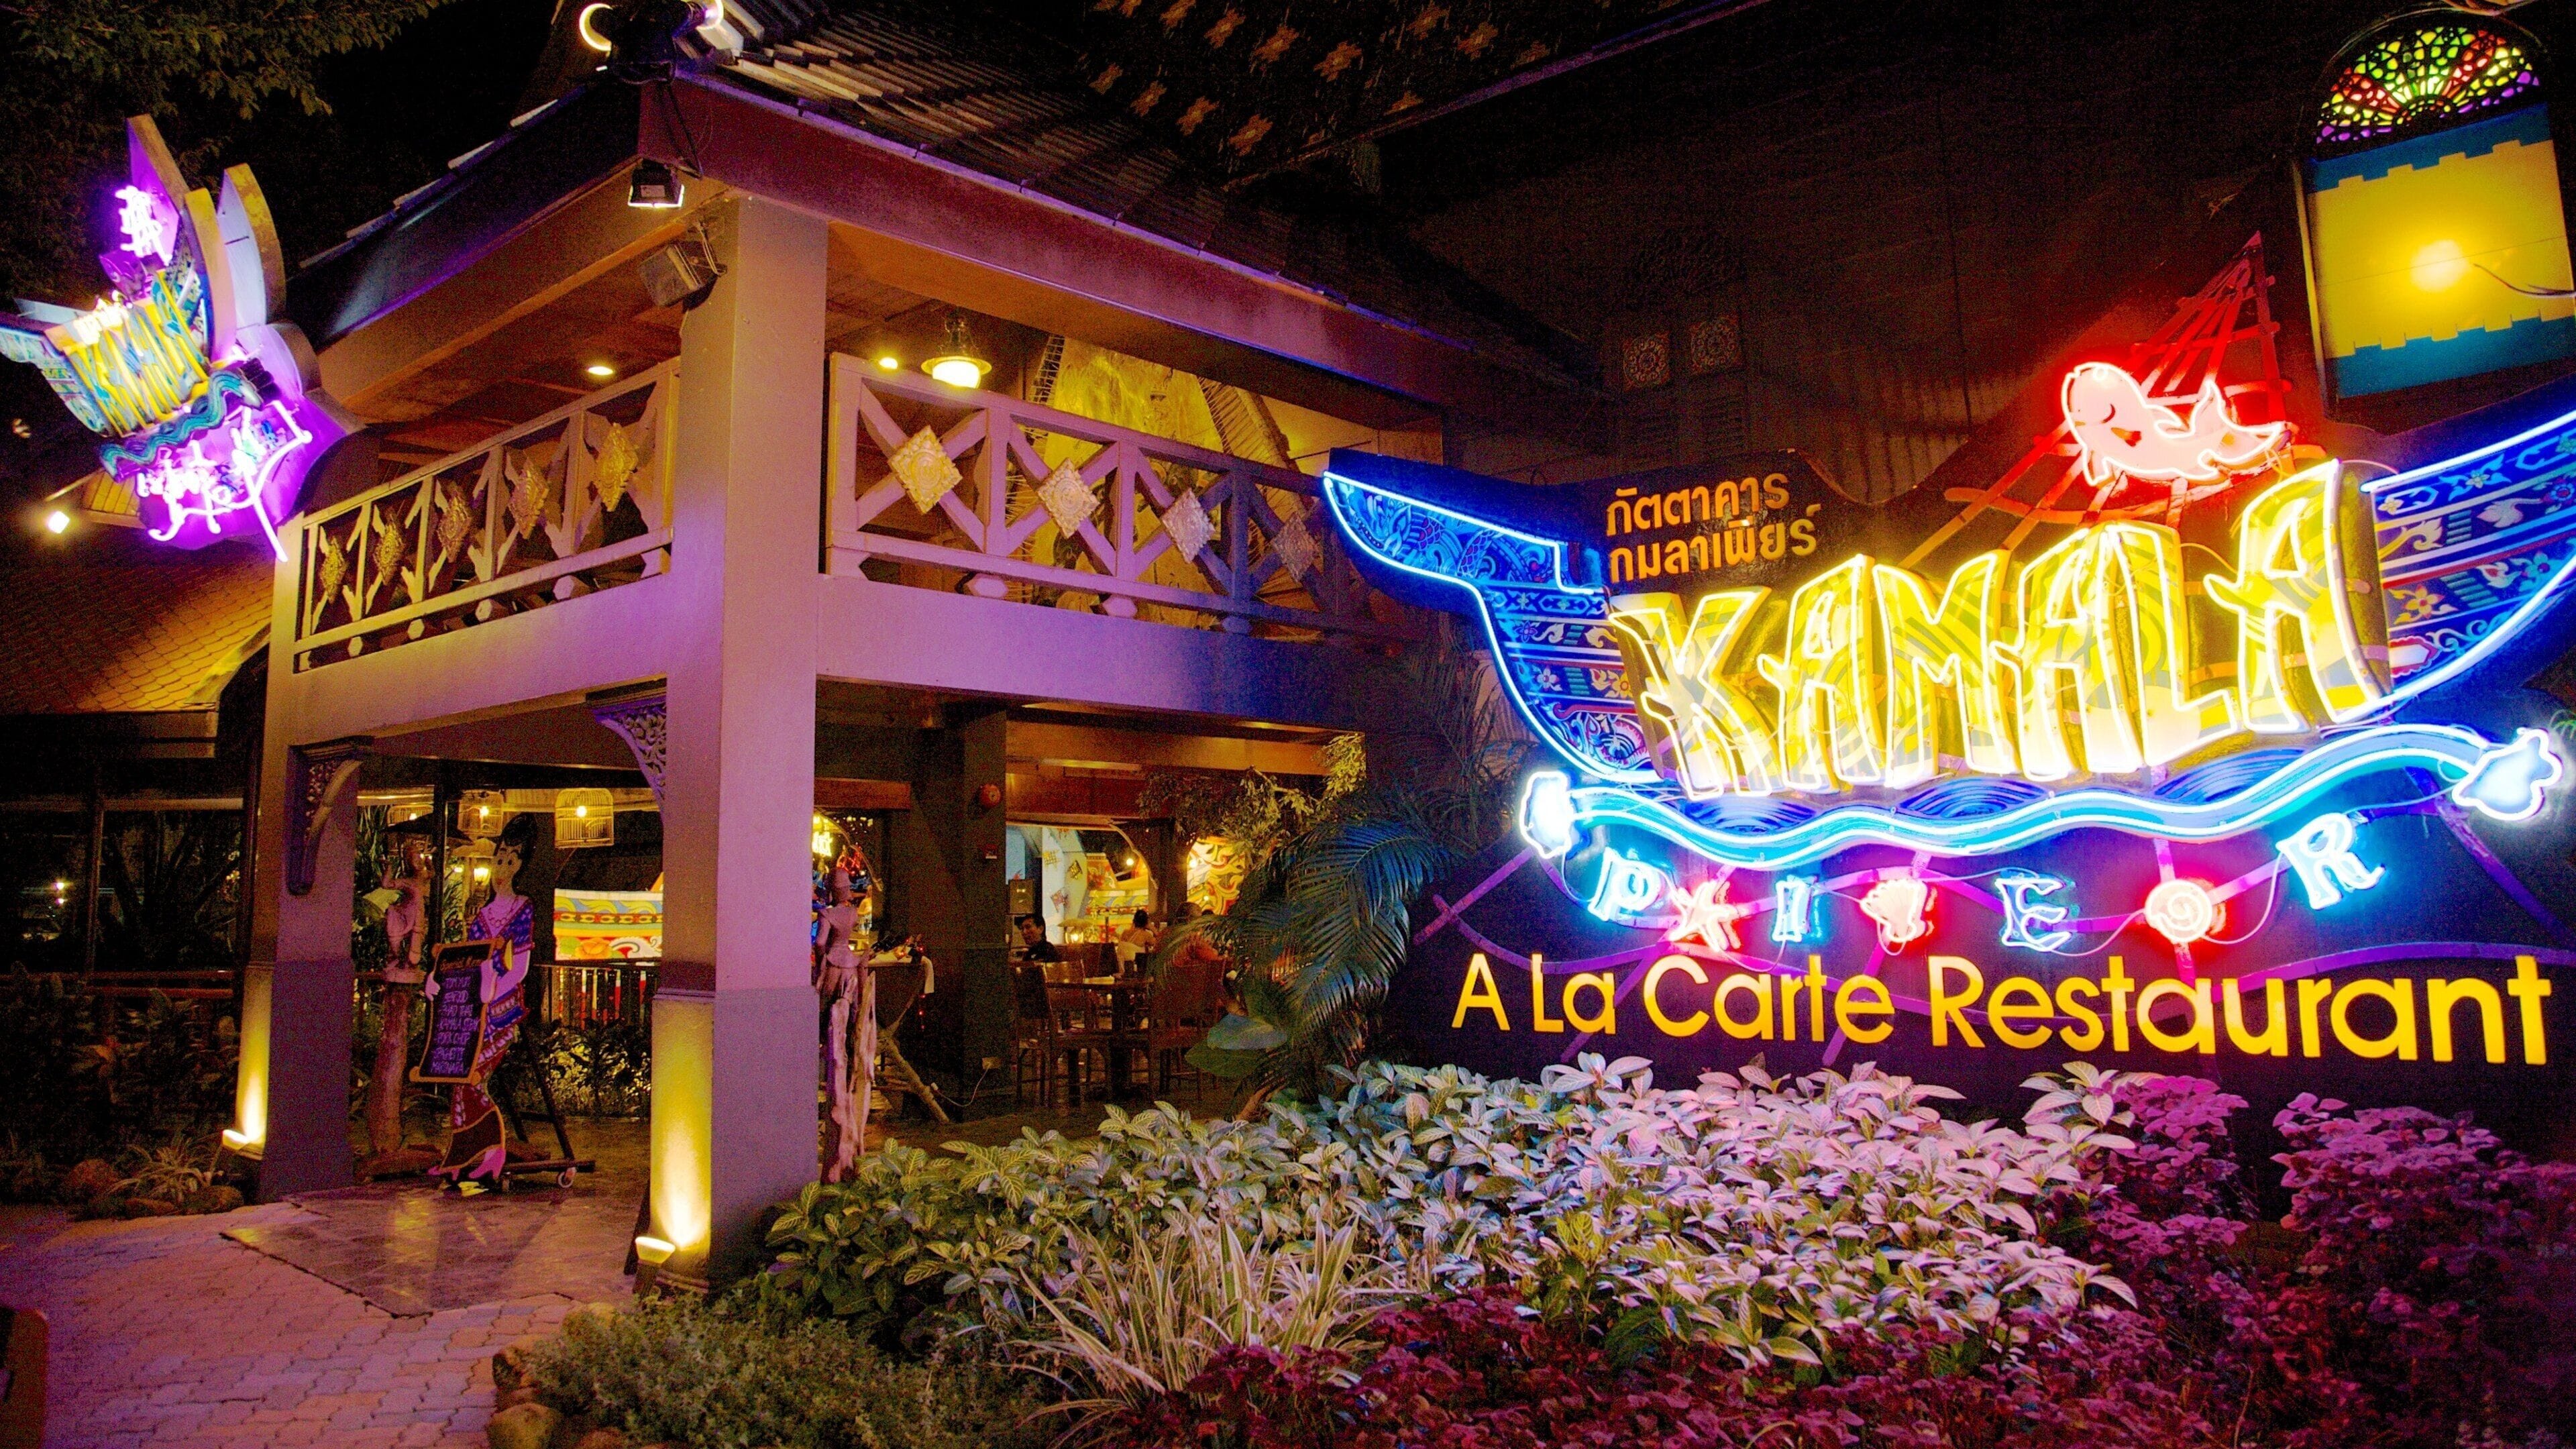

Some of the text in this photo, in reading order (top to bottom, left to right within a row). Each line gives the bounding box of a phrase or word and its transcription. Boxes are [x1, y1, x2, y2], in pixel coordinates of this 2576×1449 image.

[1608, 460, 2390, 799] KAMALA
[1451, 953, 2552, 1065] A La Carte Restaurant
